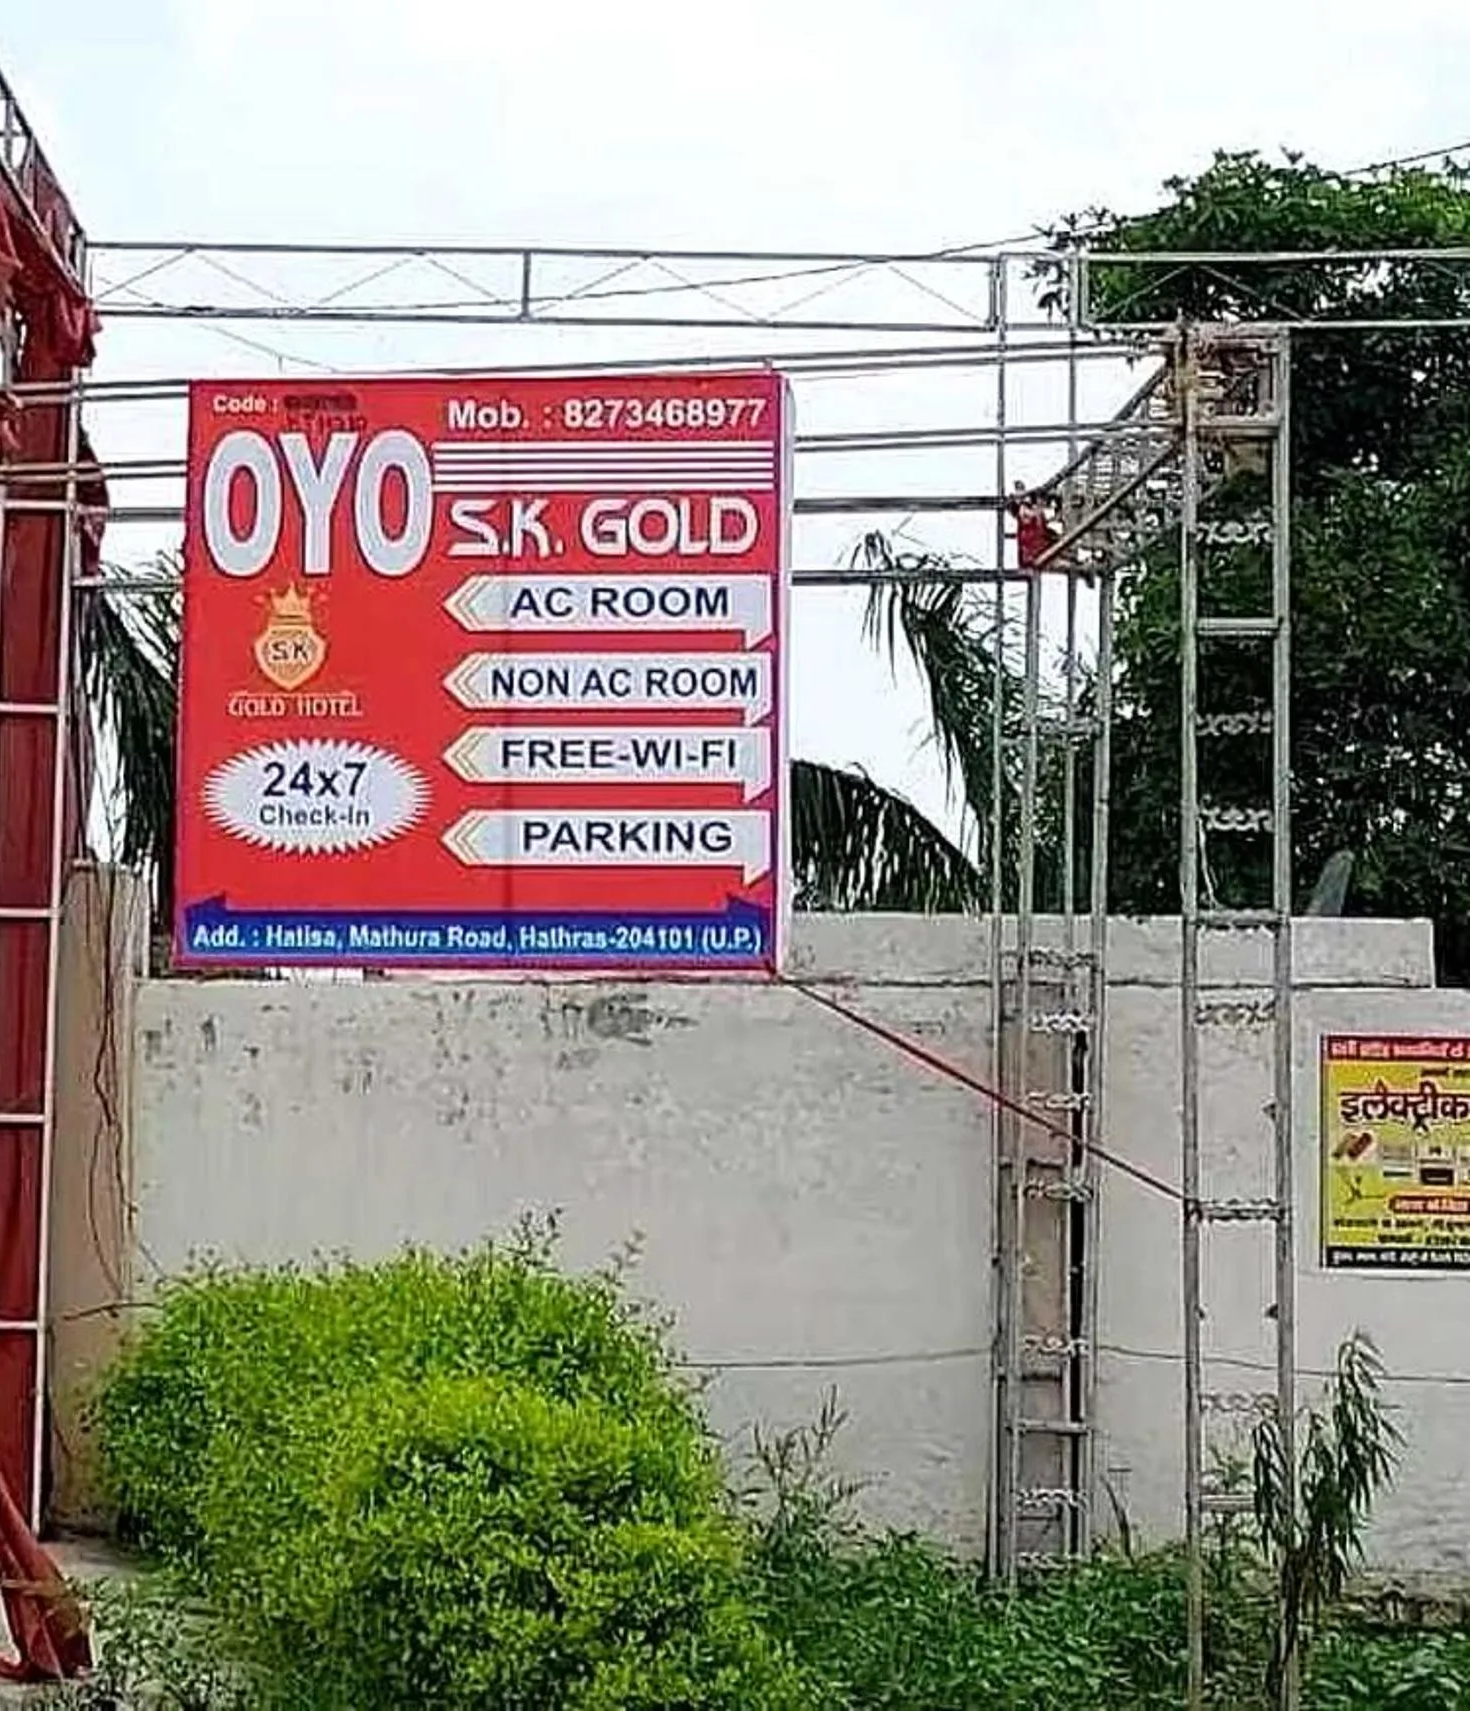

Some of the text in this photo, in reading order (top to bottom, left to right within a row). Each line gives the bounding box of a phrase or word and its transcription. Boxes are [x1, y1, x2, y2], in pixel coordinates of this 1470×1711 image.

[213, 394, 266, 412] Code
[447, 400, 529, 429] Mob.
[564, 399, 766, 428] 8273468977
[204, 428, 433, 577] OYO
[447, 498, 760, 557] S.K. GOLD
[510, 587, 728, 617] AC ROOM
[491, 668, 756, 698] NON AC ROOM
[229, 692, 363, 716] GOLD HOTEL
[501, 739, 736, 768] FREE-WI-FI
[263, 761, 367, 797] 24x7
[259, 804, 371, 826] Check-In
[523, 821, 732, 851] PARKING
[193, 925, 246, 948] Add.
[349, 925, 441, 948] Mathura
[447, 925, 513, 951] Road,
[519, 925, 693, 950] Hathras-204101
[701, 925, 763, 953] (U.P.)
